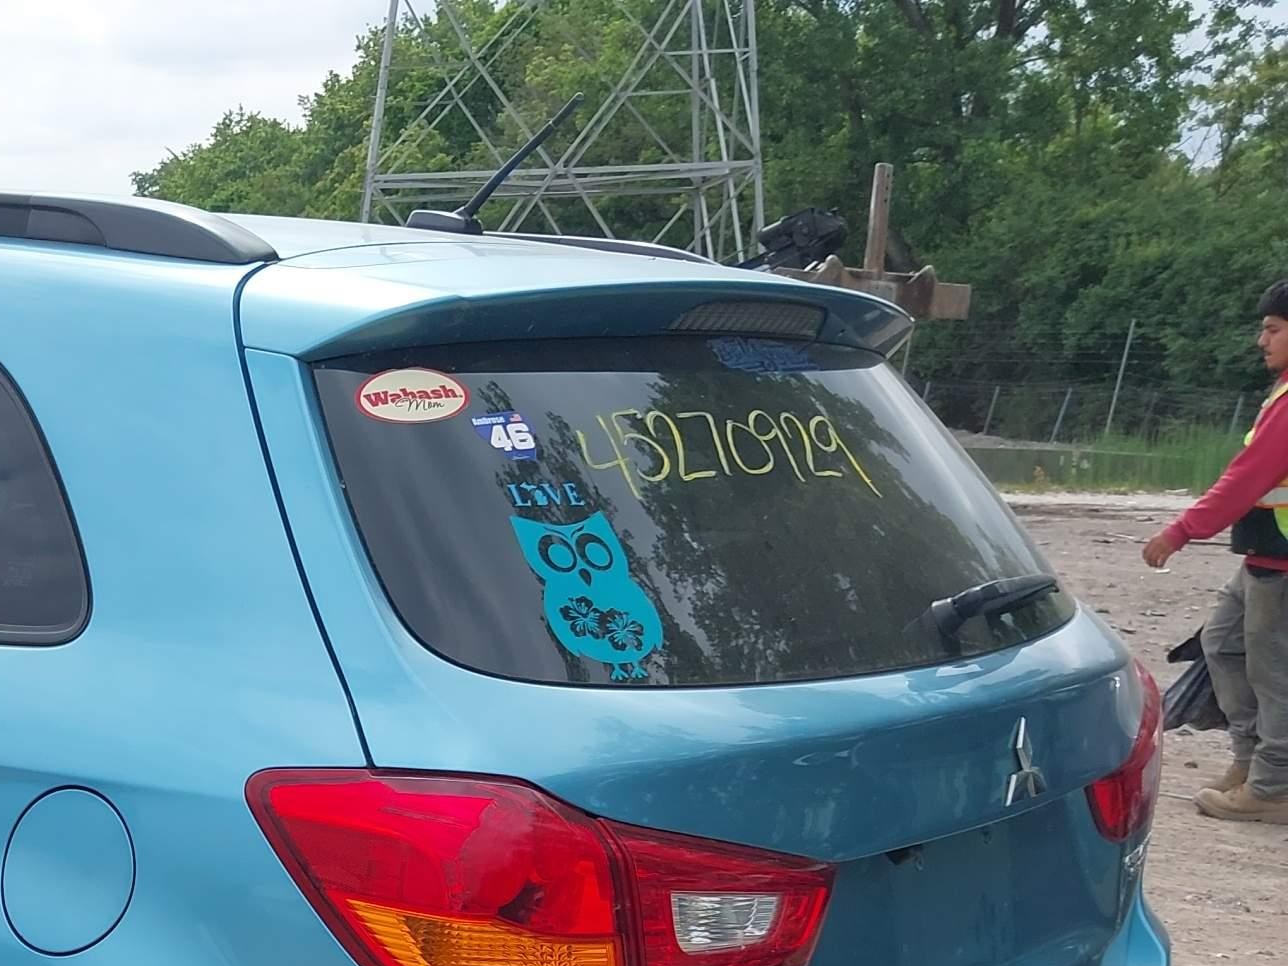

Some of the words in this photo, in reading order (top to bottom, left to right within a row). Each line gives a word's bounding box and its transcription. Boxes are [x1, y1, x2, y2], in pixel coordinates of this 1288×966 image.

[363, 385, 458, 407] Wabash
[395, 397, 446, 412] Mom
[490, 423, 536, 451] 46
[576, 409, 882, 497] 45270929
